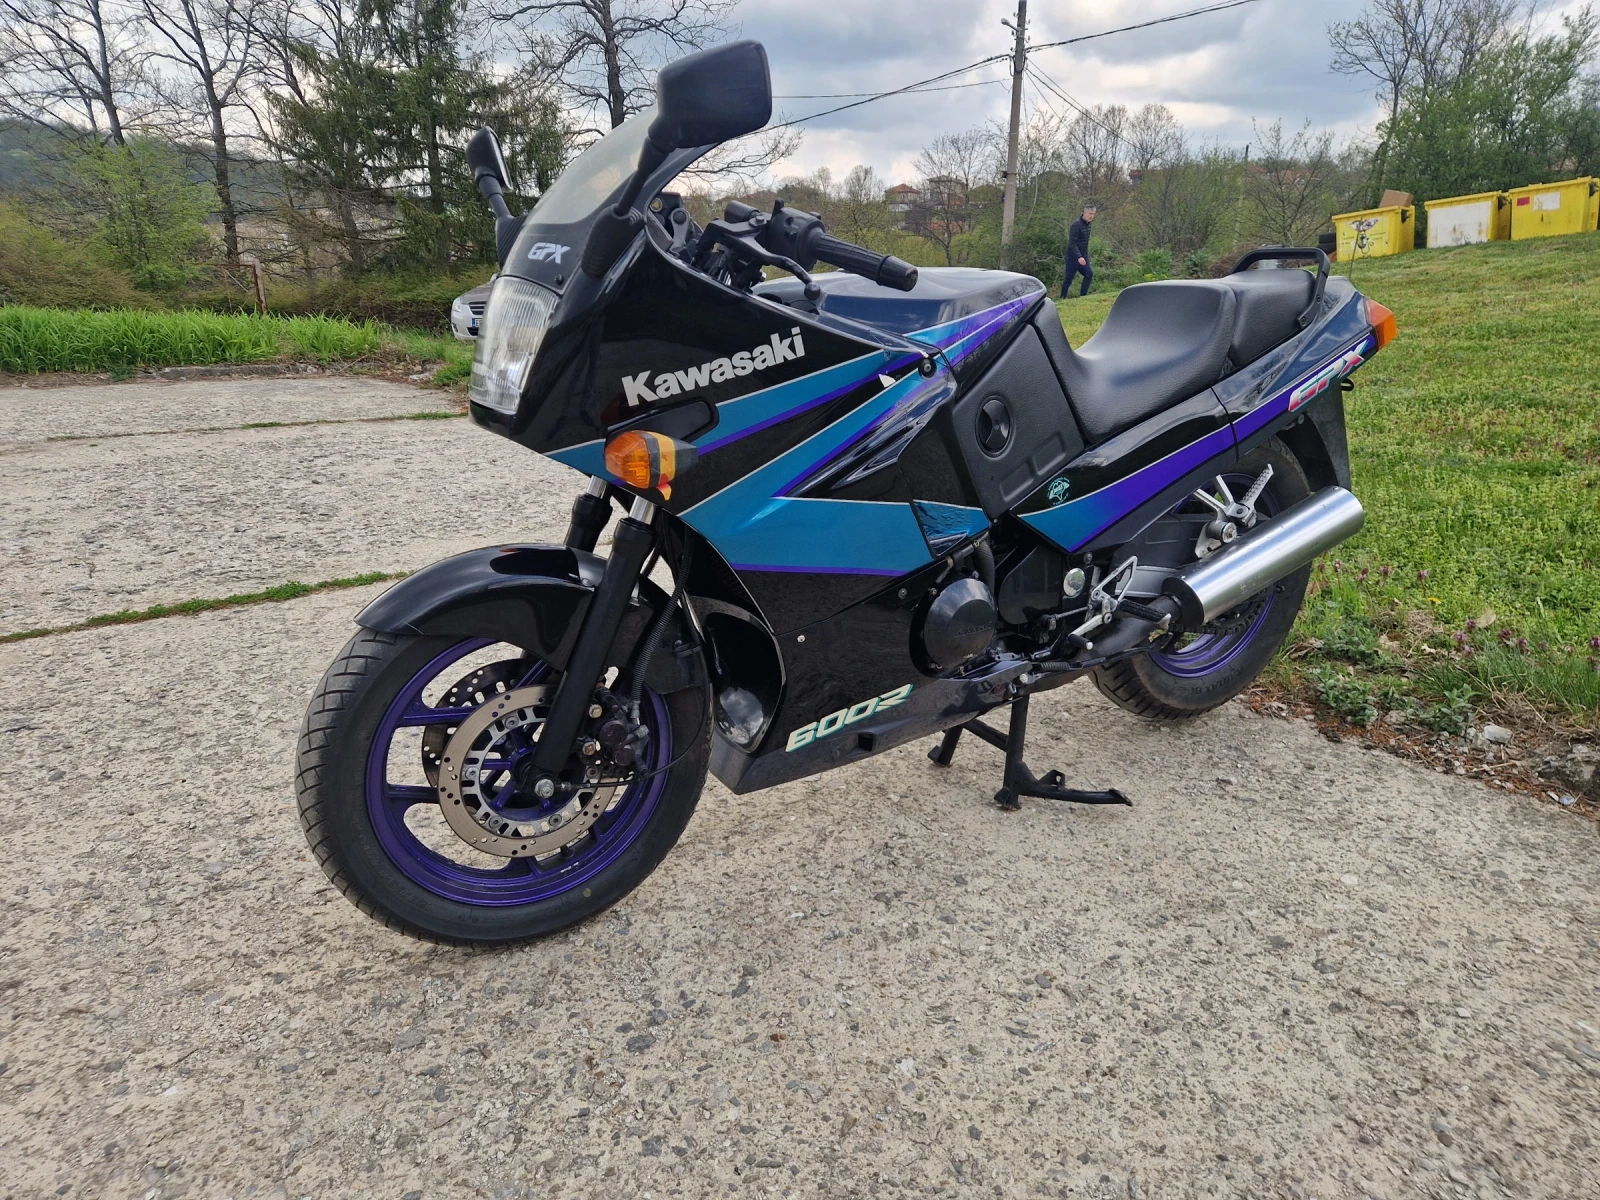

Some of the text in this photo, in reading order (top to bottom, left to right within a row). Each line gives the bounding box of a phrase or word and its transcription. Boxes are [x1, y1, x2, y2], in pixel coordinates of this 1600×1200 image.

[528, 242, 571, 264] GPX
[621, 326, 805, 407] Kawasaki
[1288, 339, 1369, 412] GPX
[785, 683, 914, 752] 600R
